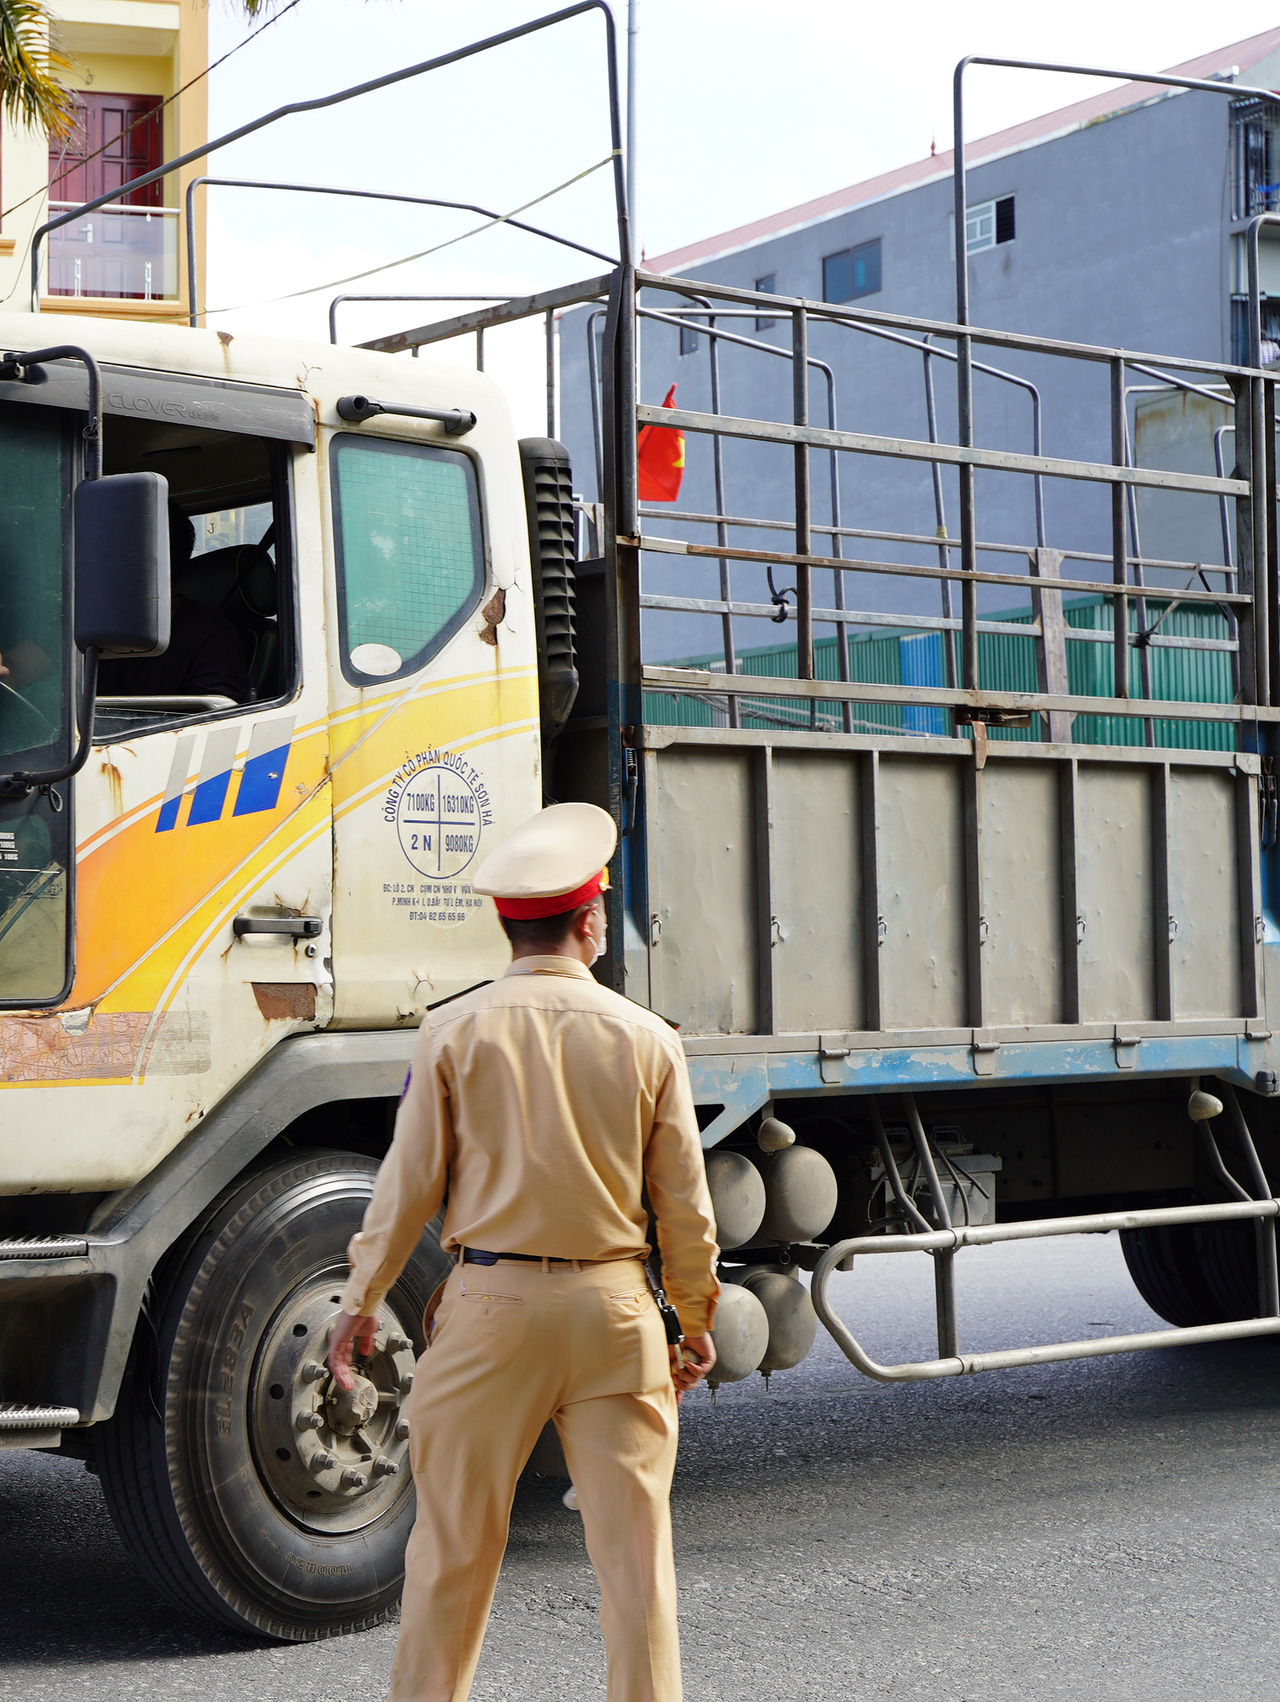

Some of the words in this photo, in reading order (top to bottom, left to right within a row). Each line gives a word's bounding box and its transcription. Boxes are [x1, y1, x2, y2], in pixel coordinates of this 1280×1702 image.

[107, 393, 187, 418] CLOVER
[381, 788, 400, 822] CÔNG
[392, 771, 405, 789] TY
[407, 793, 435, 811] 7100KG
[442, 795, 474, 813] 16310KG
[411, 834, 419, 850] 2
[423, 835, 432, 851] N
[445, 834, 474, 852] 9080KG
